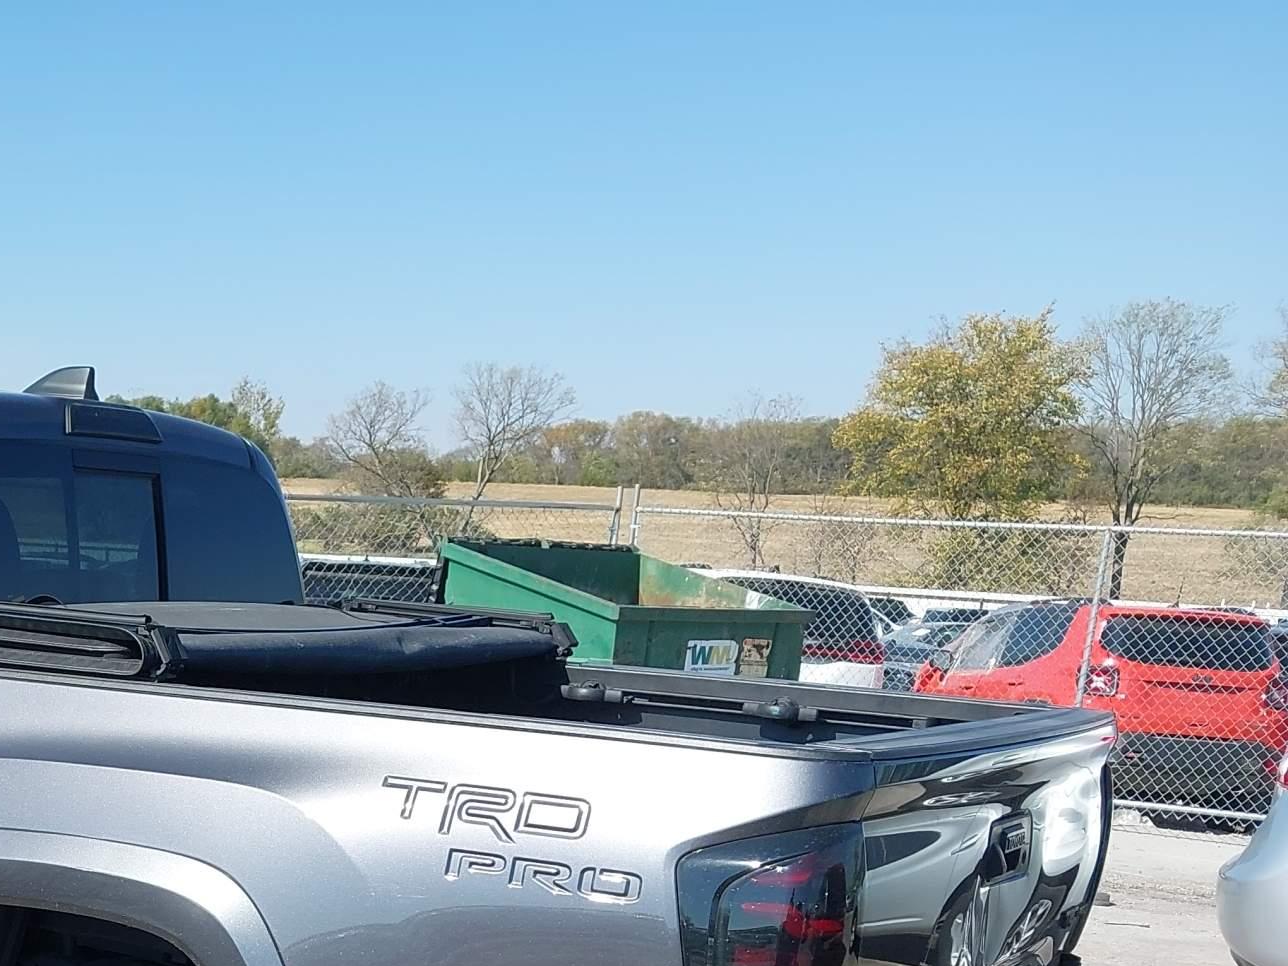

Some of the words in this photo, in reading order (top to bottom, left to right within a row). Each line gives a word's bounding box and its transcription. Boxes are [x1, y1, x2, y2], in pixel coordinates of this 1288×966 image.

[690, 644, 730, 665] WM
[381, 775, 592, 844] TRD
[444, 847, 643, 904] PRO
